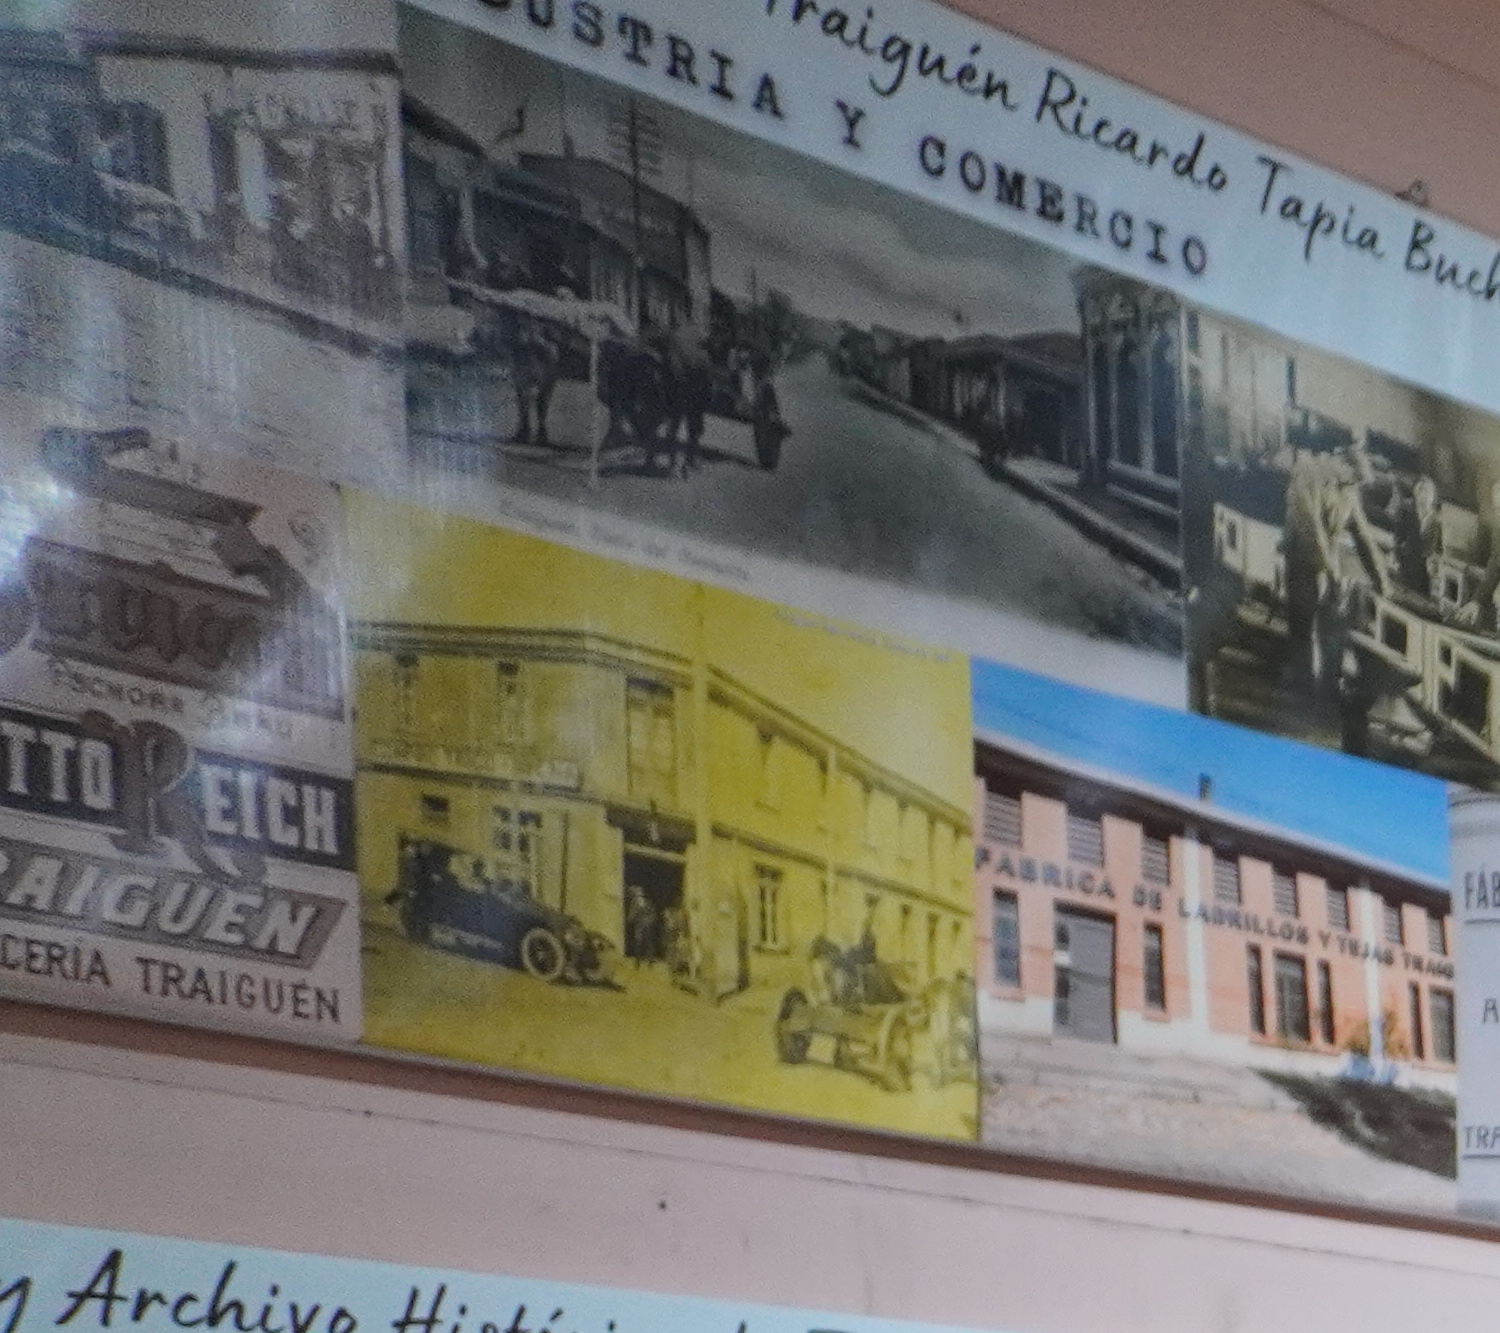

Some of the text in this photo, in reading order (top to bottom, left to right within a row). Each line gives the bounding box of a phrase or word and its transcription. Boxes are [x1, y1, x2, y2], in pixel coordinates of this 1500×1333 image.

[478, 0, 1210, 277] USTRIA Y COMERCIO
[757, 0, 1020, 112] raiguén
[1036, 67, 1229, 192] Ricardo
[1256, 154, 1386, 262] Tapia
